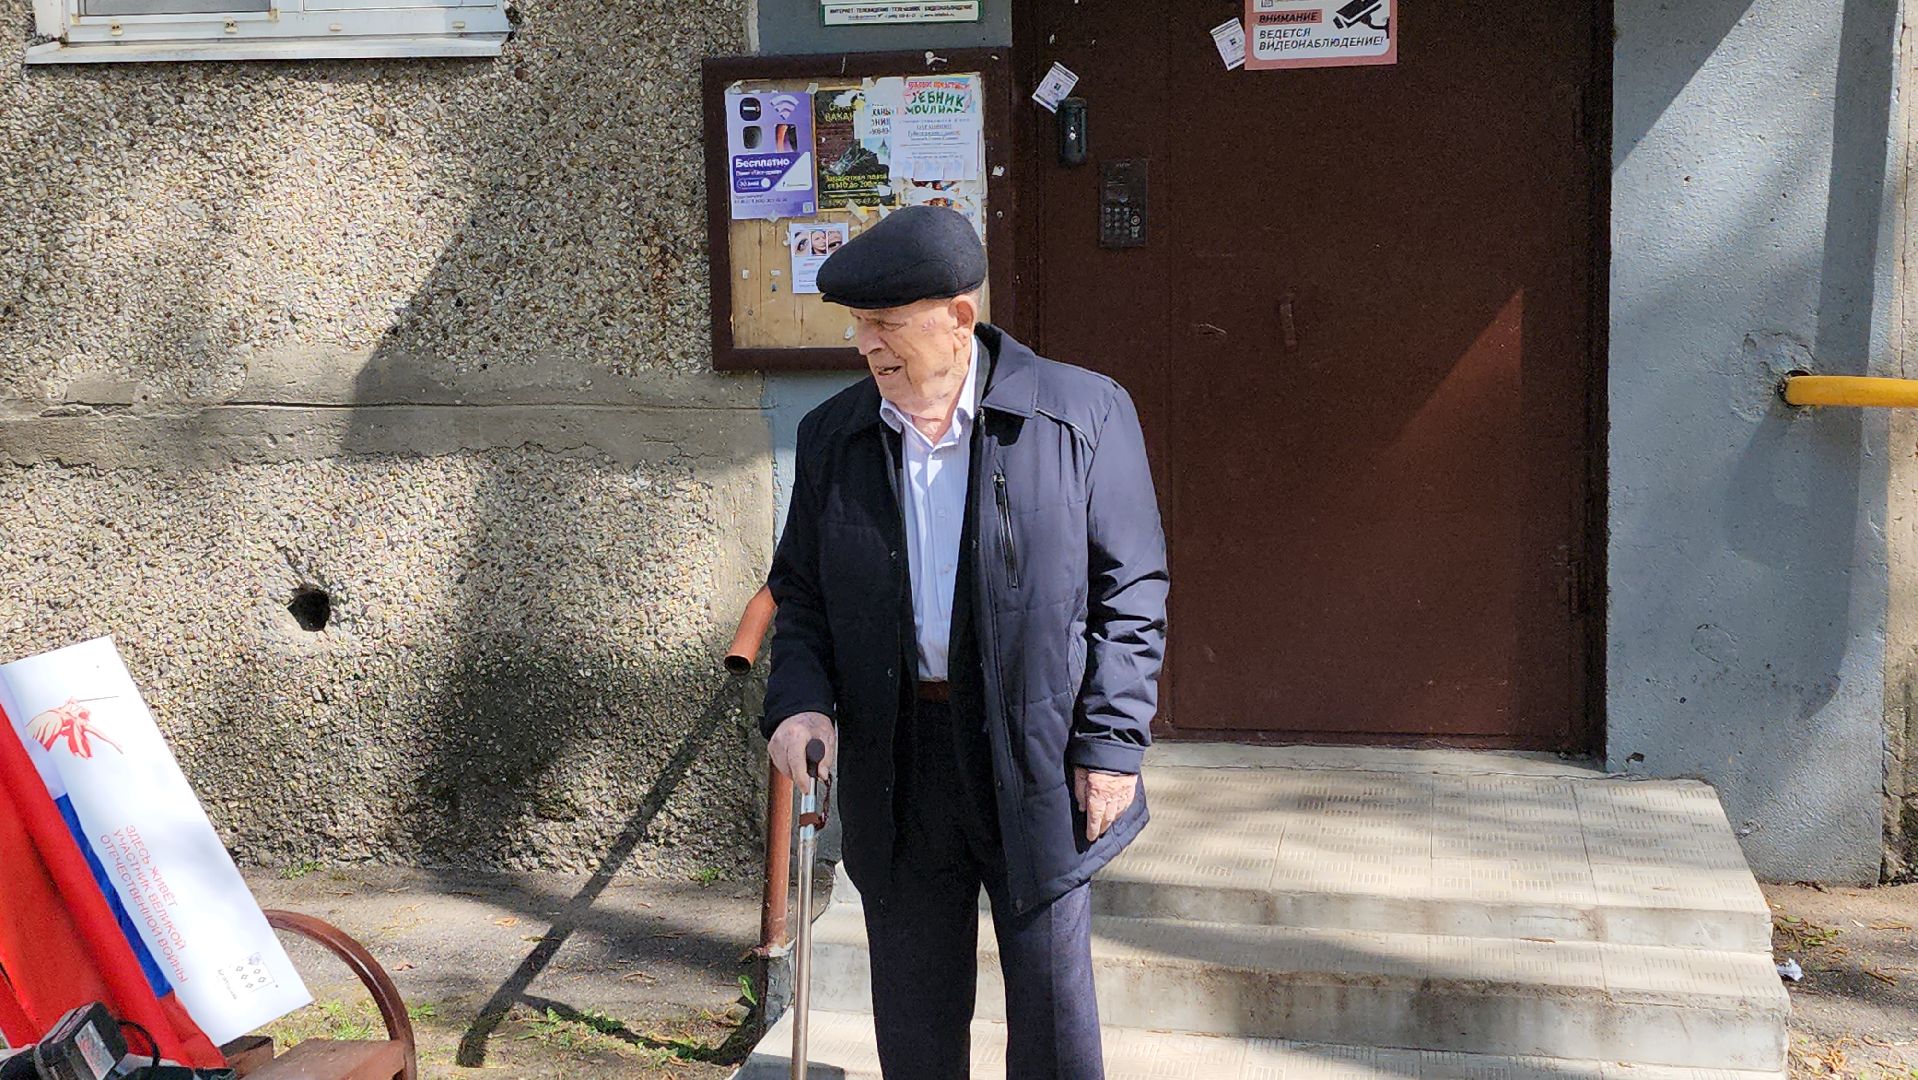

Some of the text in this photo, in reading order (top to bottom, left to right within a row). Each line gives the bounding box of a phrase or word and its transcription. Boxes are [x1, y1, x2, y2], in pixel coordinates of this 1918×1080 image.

[1259, 12, 1318, 24] ВНИМАНИЕ
[1259, 28, 1311, 39] ВЕДЕТСЯ
[1259, 37, 1384, 51] ВИДЕОНАБЛЮДЕНИЕ!
[735, 158, 790, 169] Бесплатно
[126, 824, 150, 865] ЗДЕСЬ
[114, 830, 187, 951] УЧАСТНИК ВЕЛИКОЙ
[100, 834, 189, 984] ОТЕЧЕСТВЕННОЙ ВОЙНЫ
